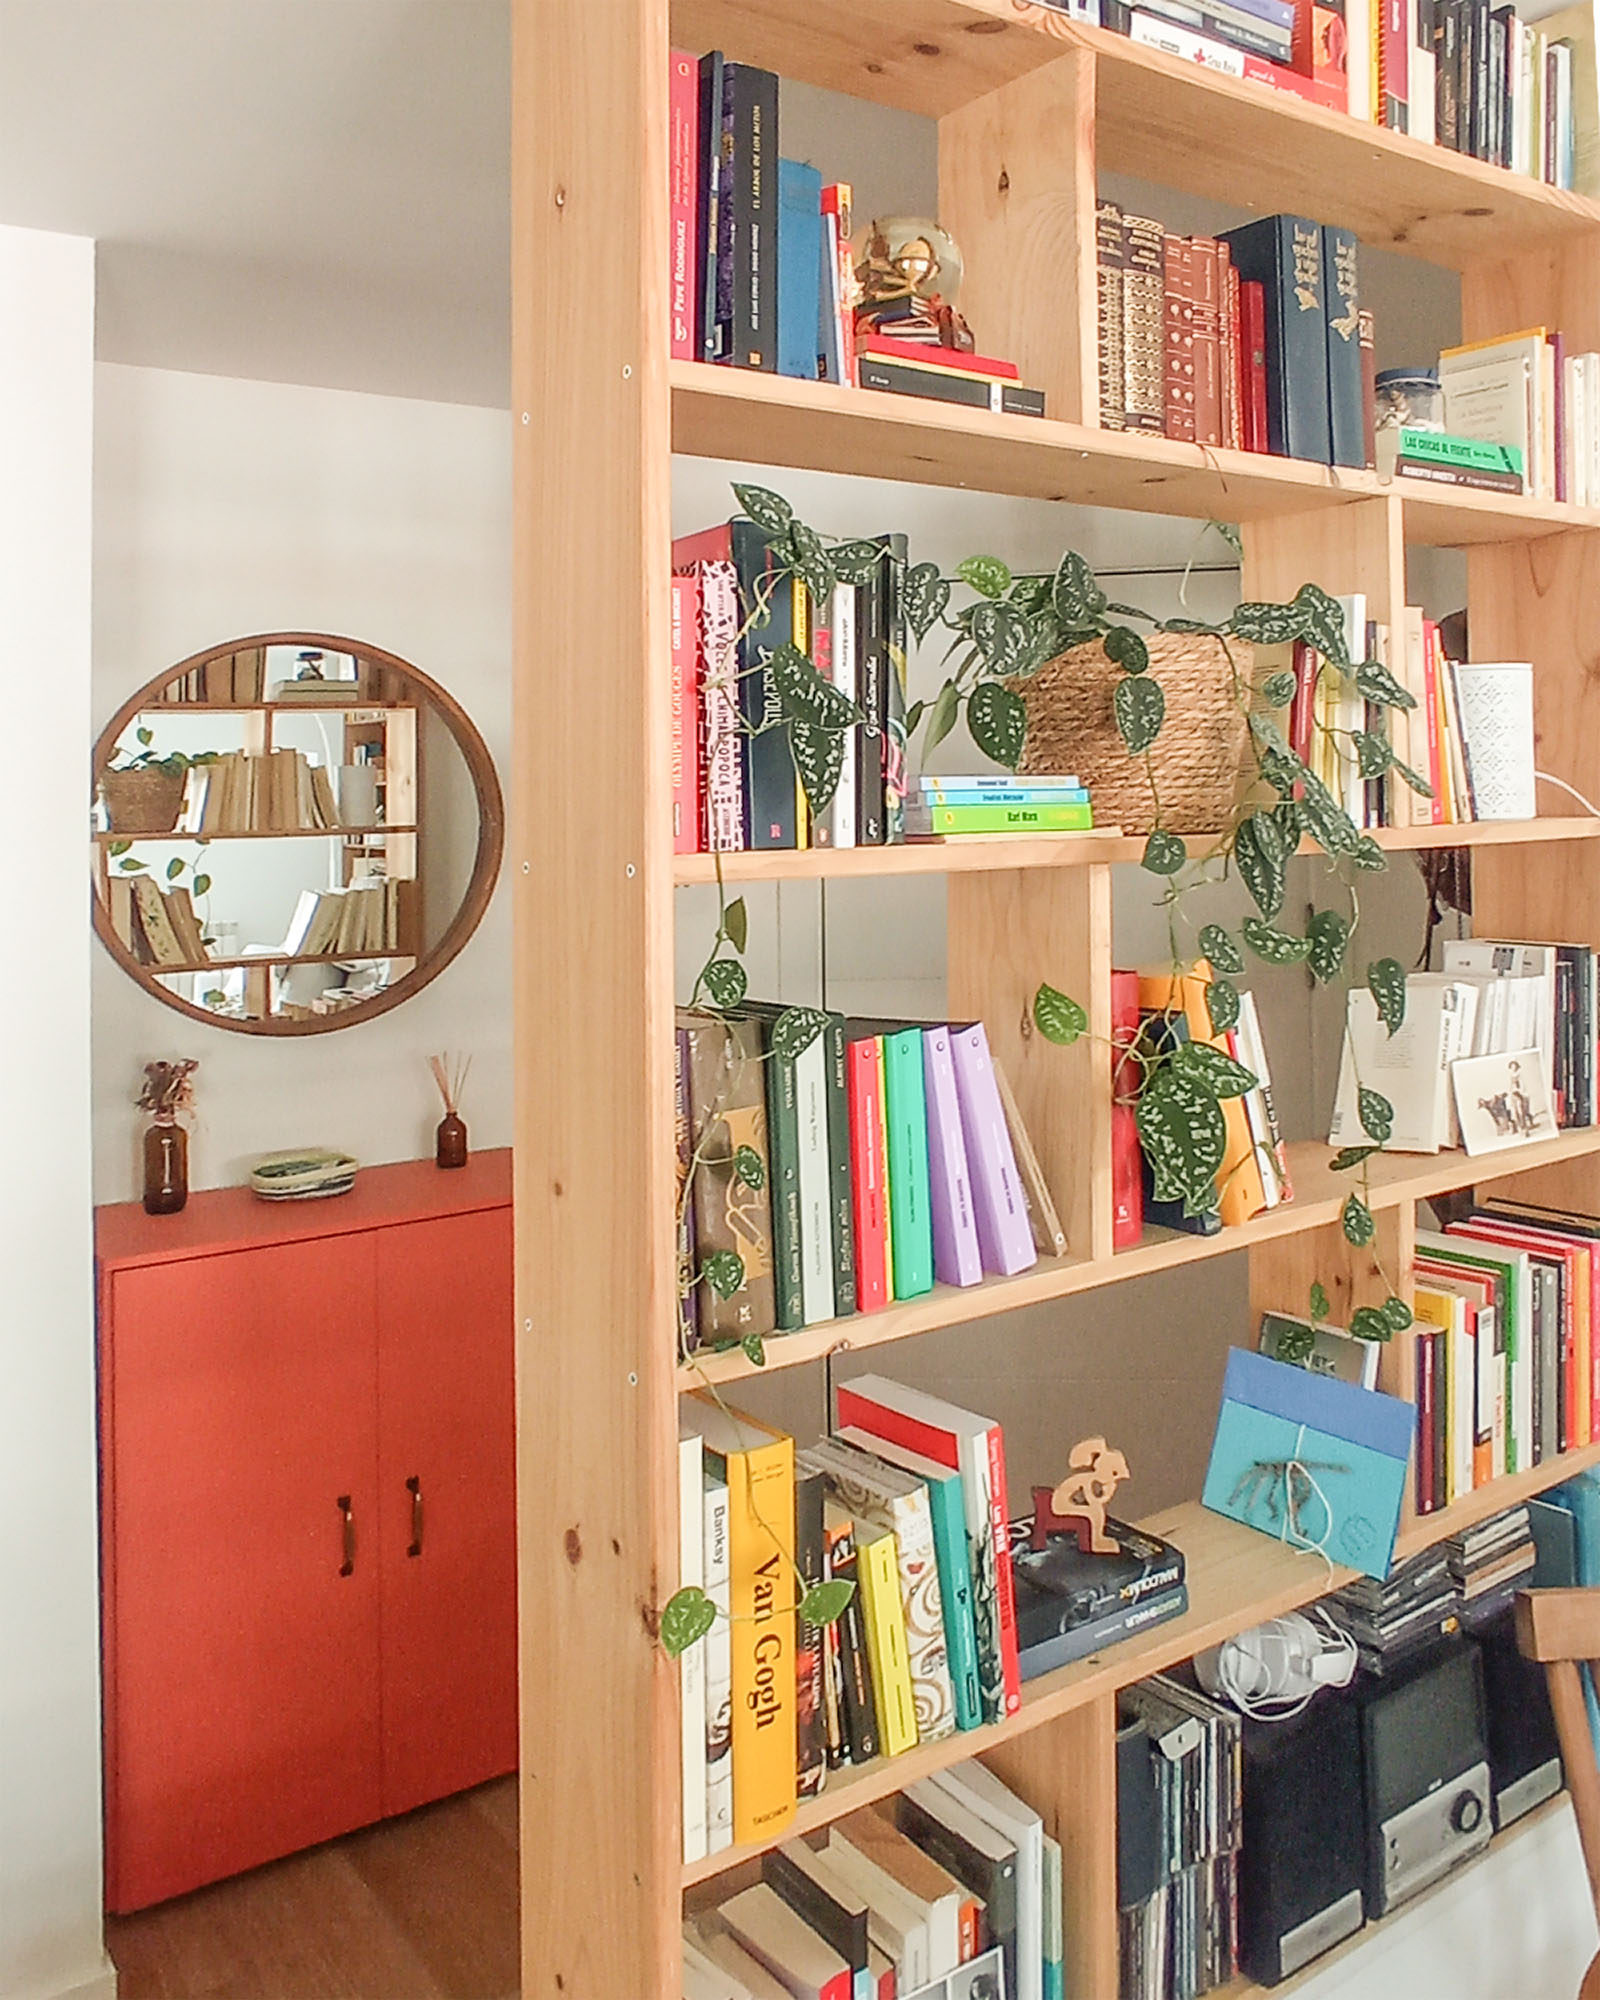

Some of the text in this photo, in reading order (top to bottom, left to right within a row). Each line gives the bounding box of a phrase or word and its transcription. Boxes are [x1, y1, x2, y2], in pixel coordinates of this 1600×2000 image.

[674, 283, 687, 312] PEPE
[672, 664, 683, 715] GOUGES
[672, 719, 683, 736] DE
[671, 740, 683, 788] OLYMPE
[711, 1505, 727, 1566] Banksy
[746, 1553, 782, 1731] Van Gogh
